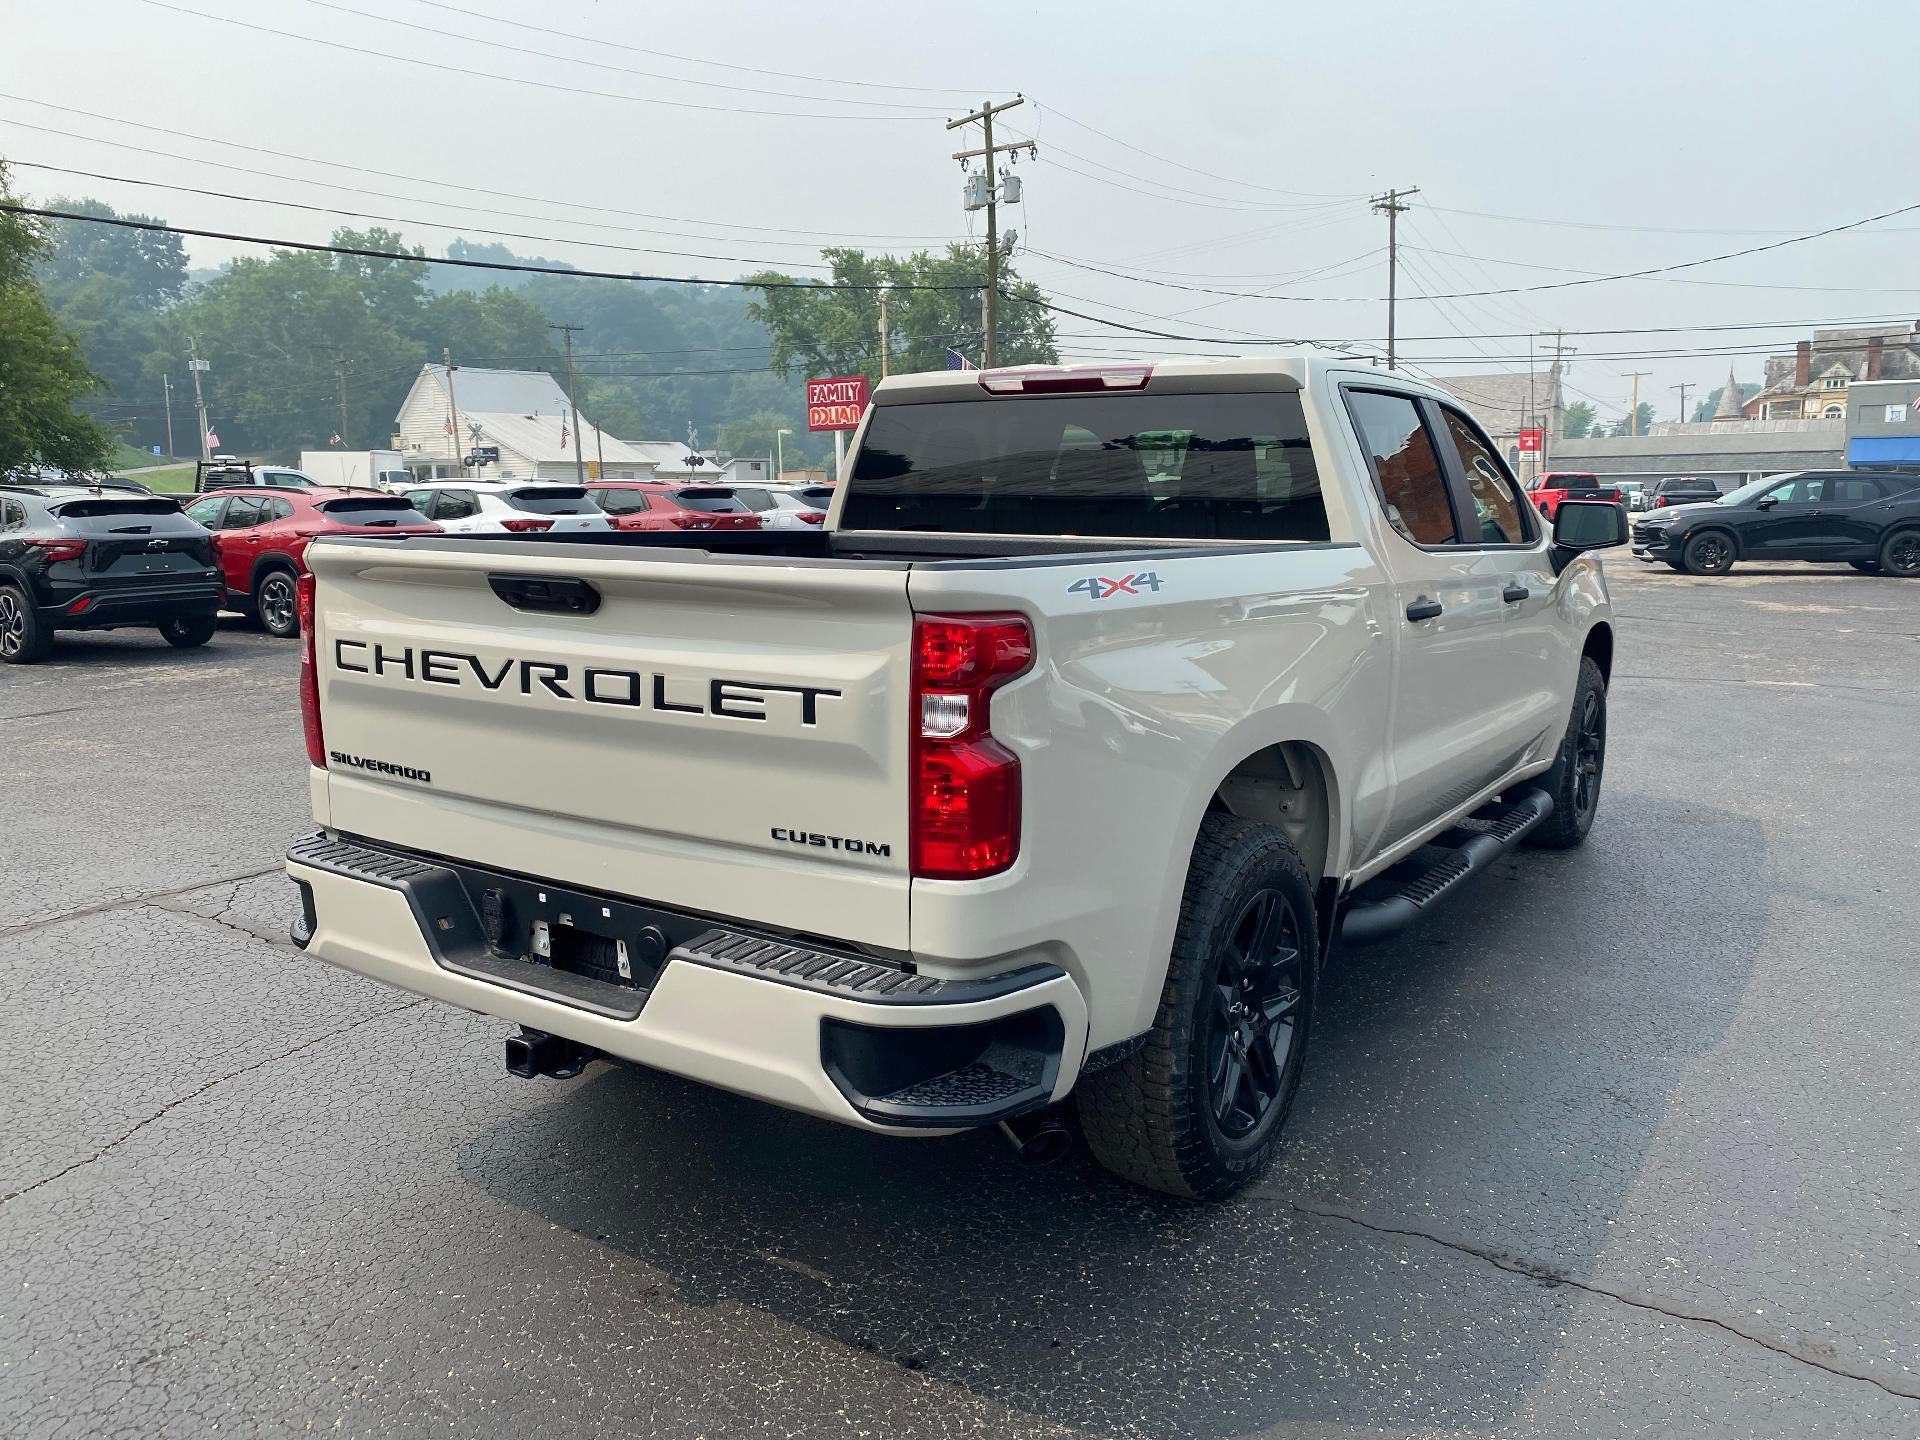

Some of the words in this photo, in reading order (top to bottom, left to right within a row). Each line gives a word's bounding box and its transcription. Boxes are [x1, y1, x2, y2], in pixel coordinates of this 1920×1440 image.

[809, 382, 861, 403] FAMILY
[809, 404, 860, 426] DOLLAR
[335, 638, 843, 725] CHEVROLET
[330, 751, 431, 782] SILVERADO
[771, 827, 890, 856] CUSTOM
